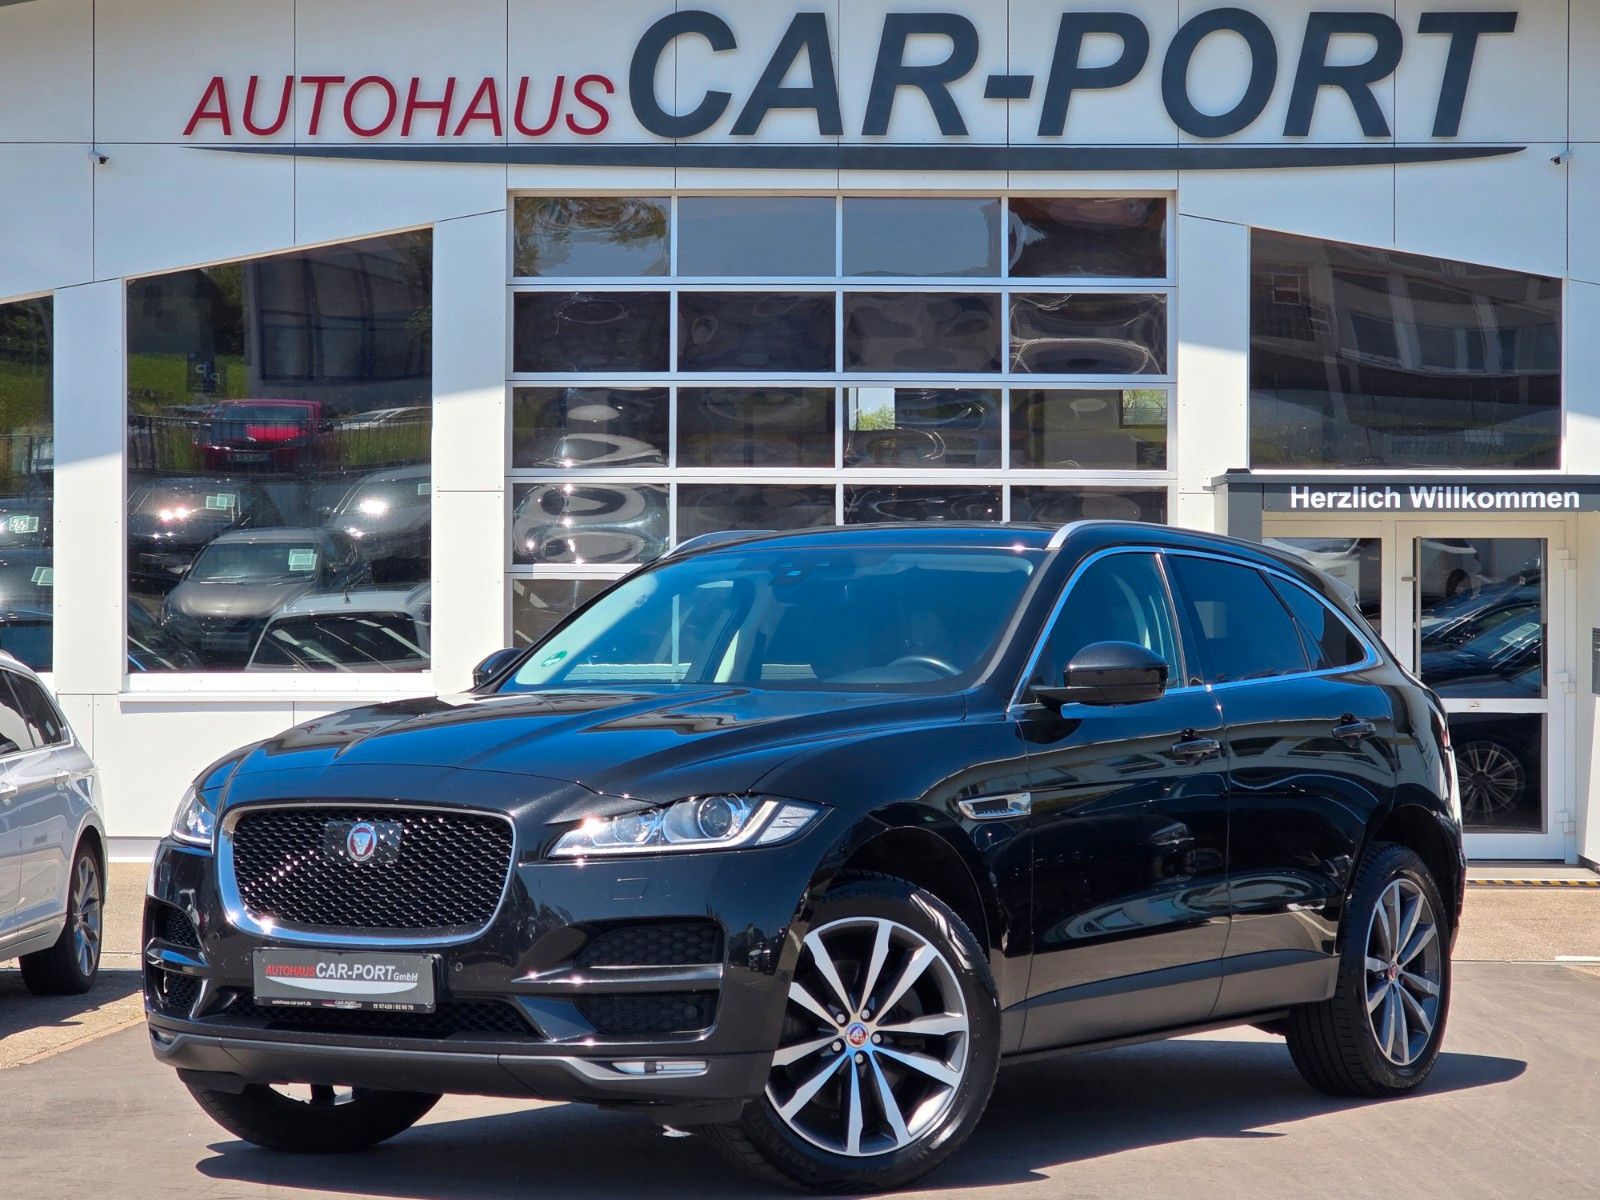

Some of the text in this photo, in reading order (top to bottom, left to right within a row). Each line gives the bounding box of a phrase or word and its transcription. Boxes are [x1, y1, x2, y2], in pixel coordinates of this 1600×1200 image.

[183, 7, 1518, 138] AUTOHAUS CAR-PORT
[1290, 485, 1580, 509] Herzlich Willkommen
[265, 962, 418, 982] AUTOHAUS CAR-PORT GmbH
